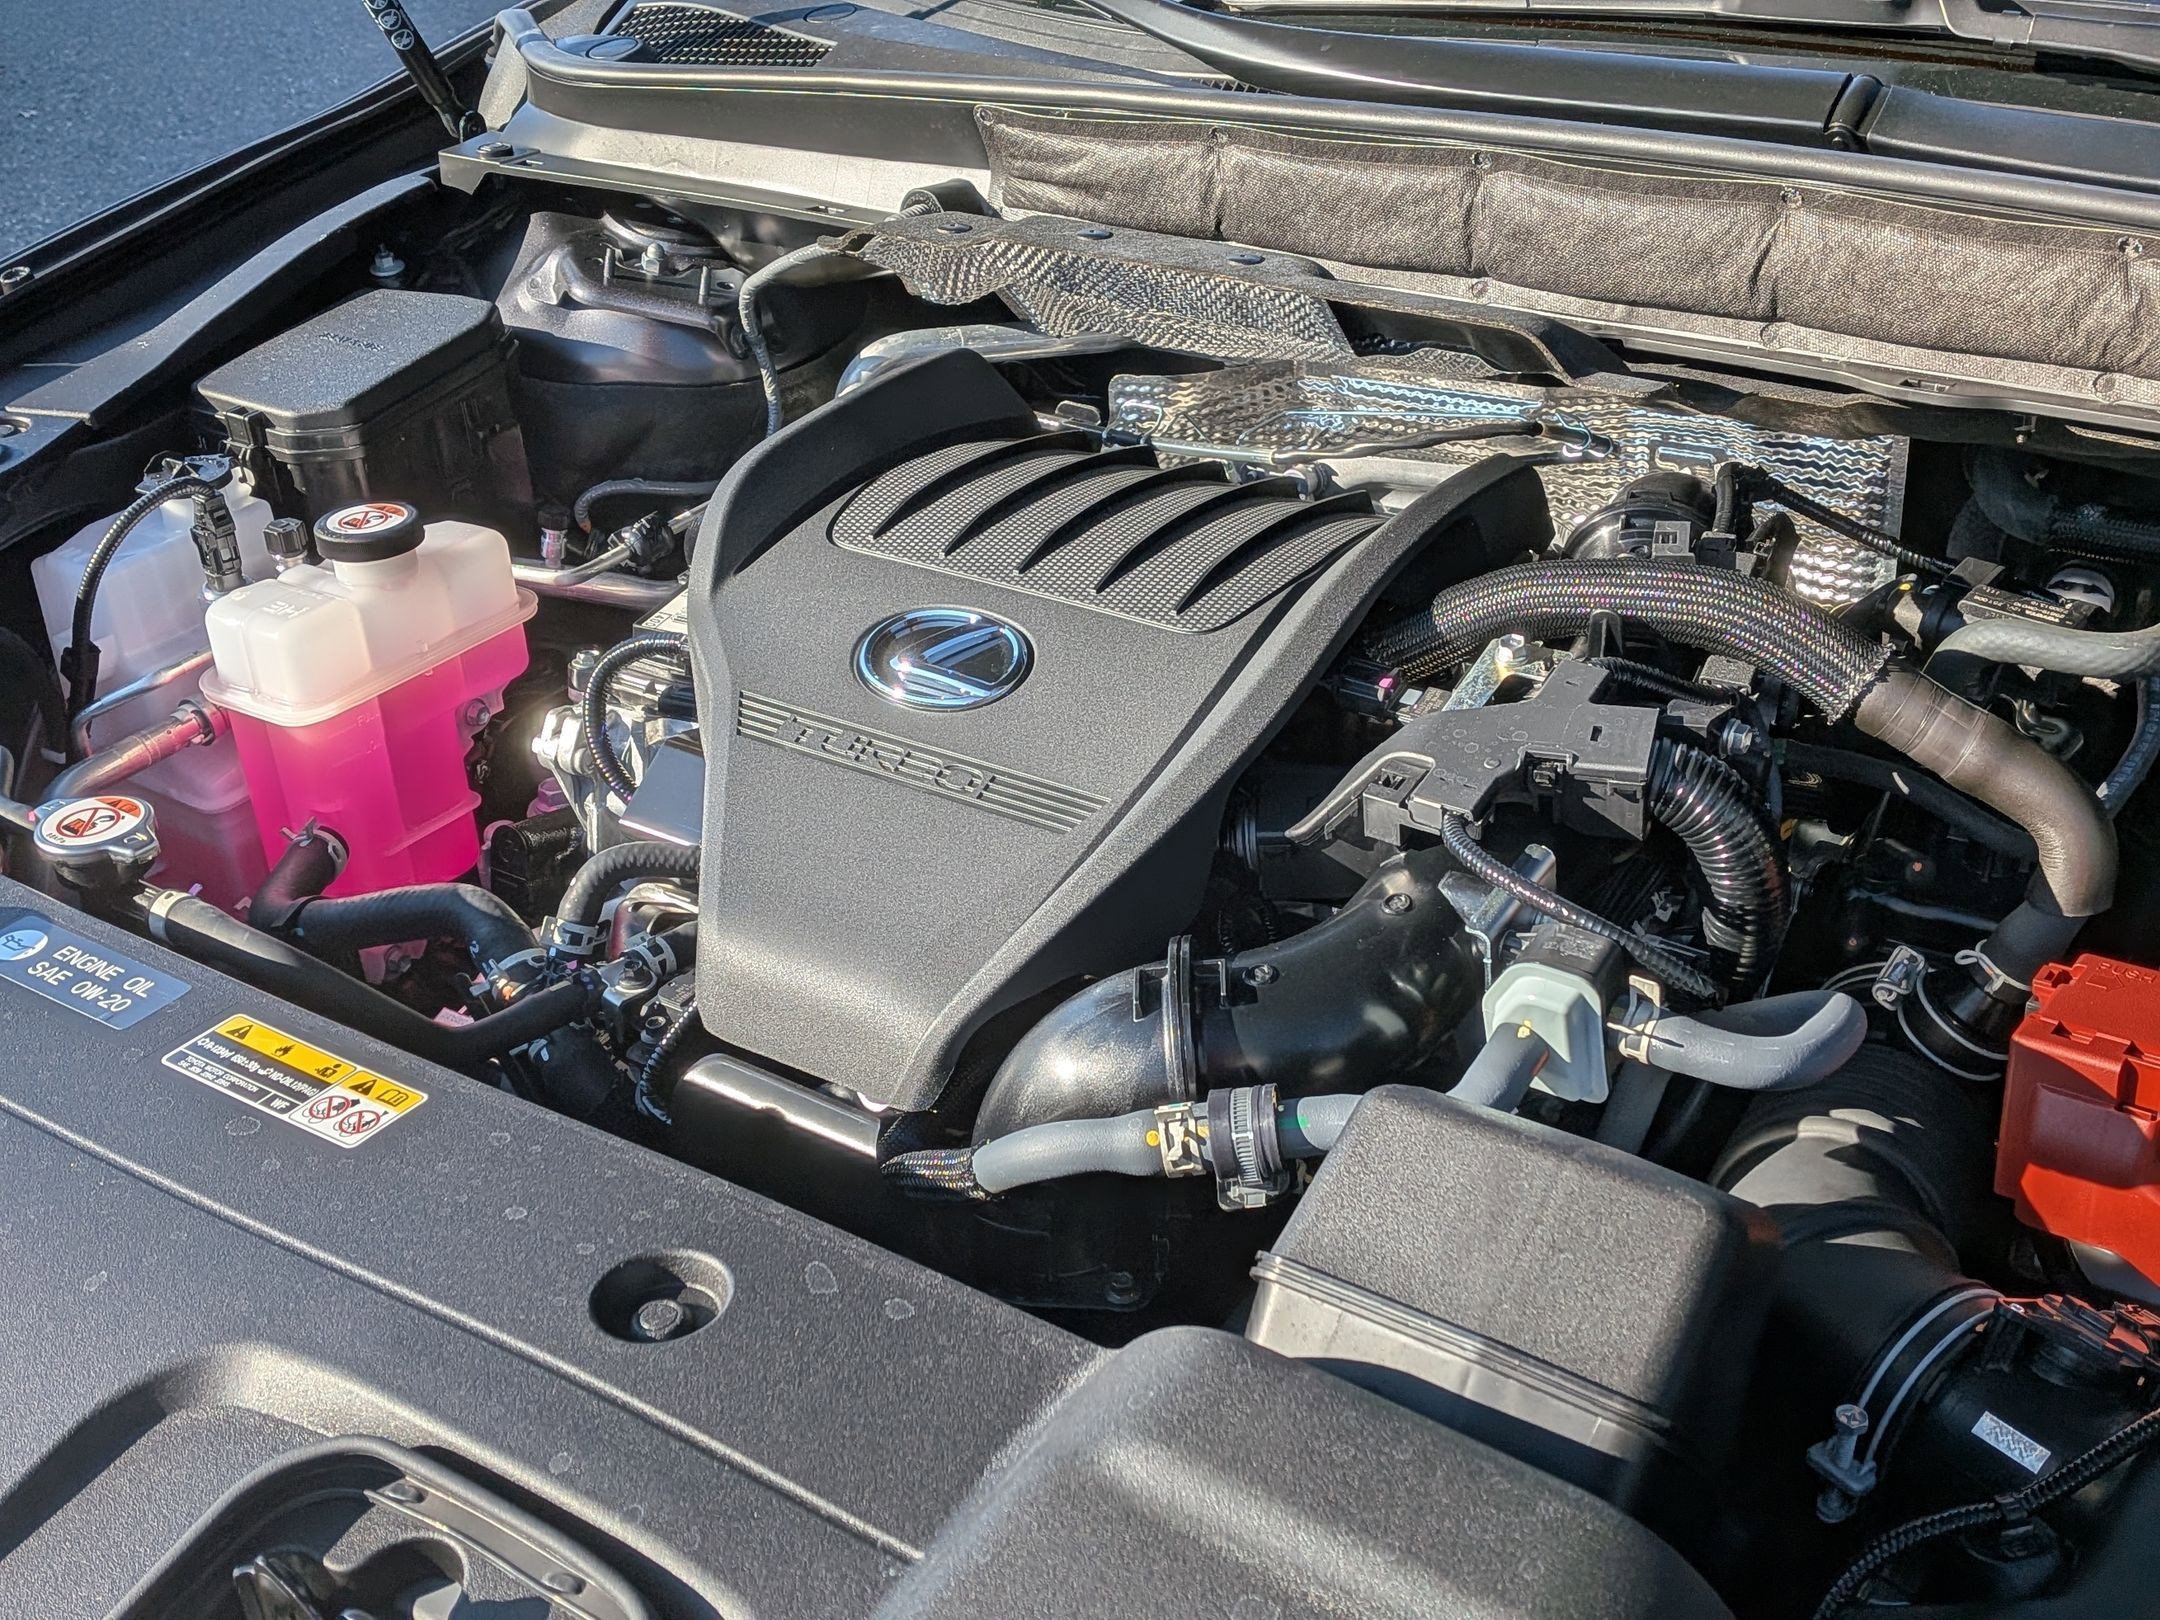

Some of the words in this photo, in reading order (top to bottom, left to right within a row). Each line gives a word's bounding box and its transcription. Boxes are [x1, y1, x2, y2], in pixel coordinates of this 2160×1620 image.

[787, 714, 986, 794] TURBO
[27, 961, 74, 986] SAE
[70, 980, 132, 1012] 0W-20
[52, 945, 125, 982] ENGINE
[122, 976, 156, 998] OIL
[2096, 962, 2158, 984] PUSH
[270, 1096, 291, 1110] WF
